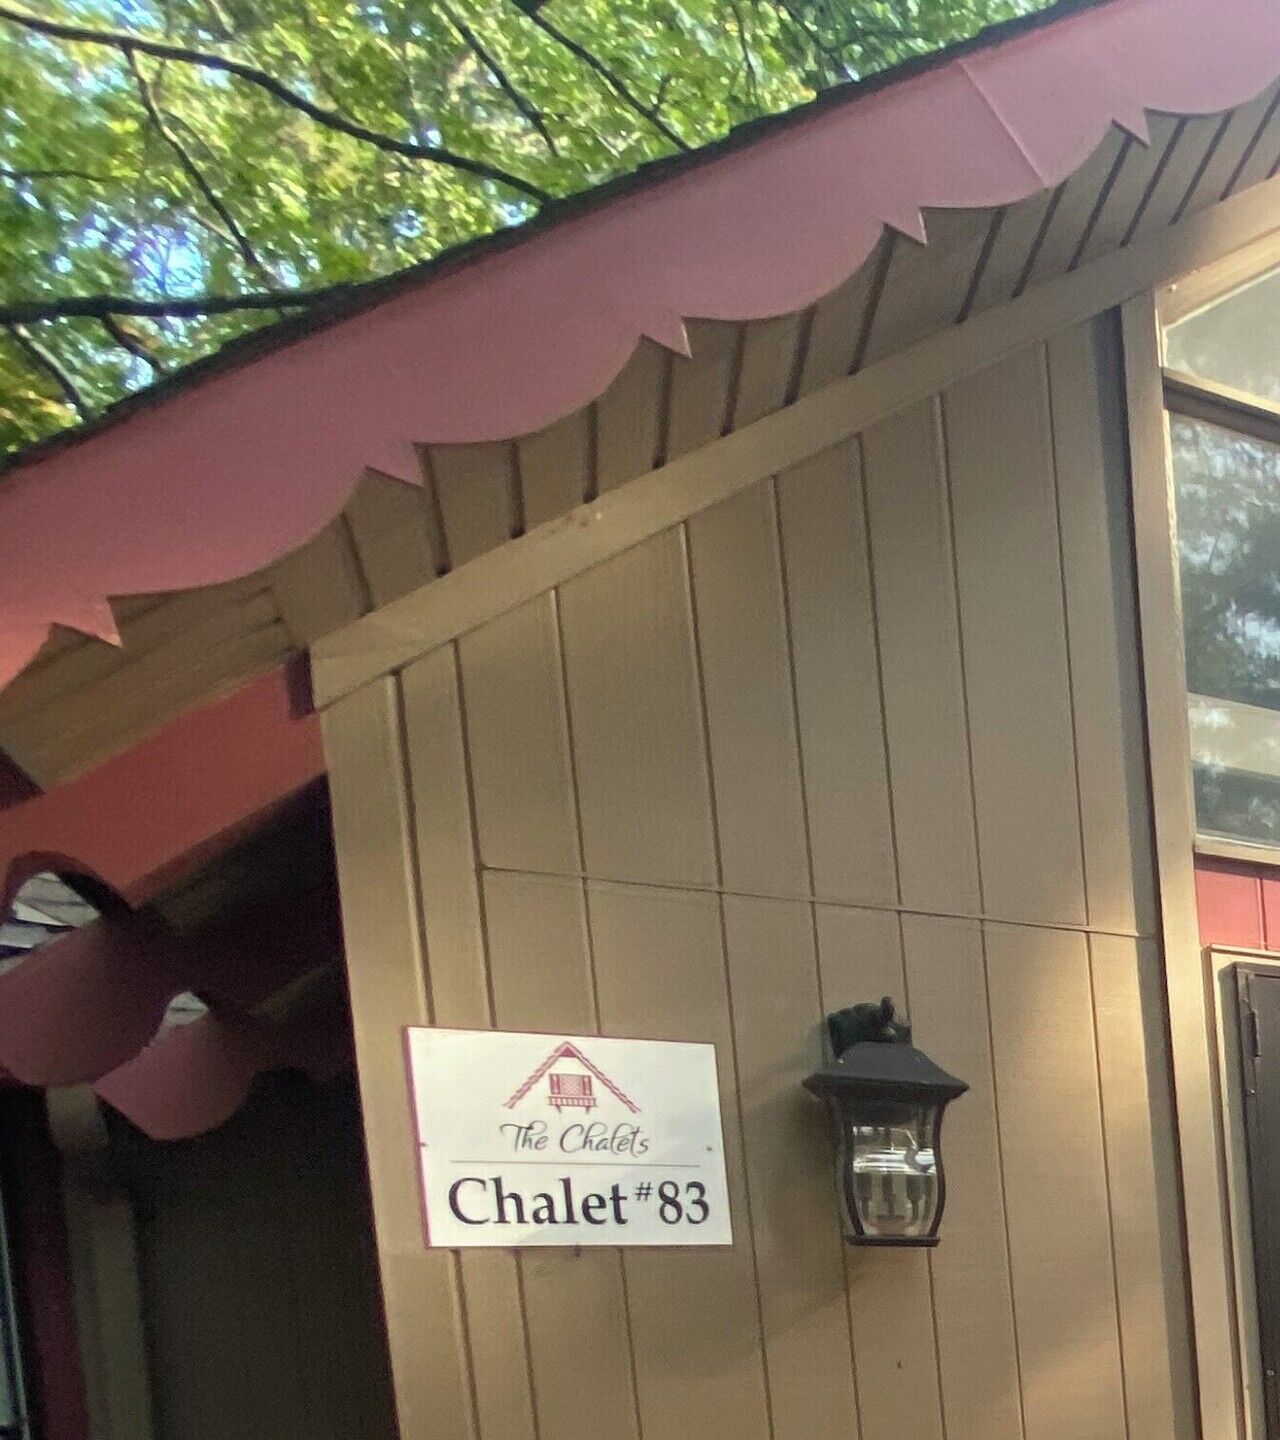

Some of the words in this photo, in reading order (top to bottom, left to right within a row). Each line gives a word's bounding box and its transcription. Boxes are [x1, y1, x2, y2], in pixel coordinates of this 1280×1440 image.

[500, 1121, 547, 1151] The
[560, 1122, 649, 1157] Chalets
[448, 1177, 628, 1225] Chalet
[635, 1180, 710, 1225] #83
